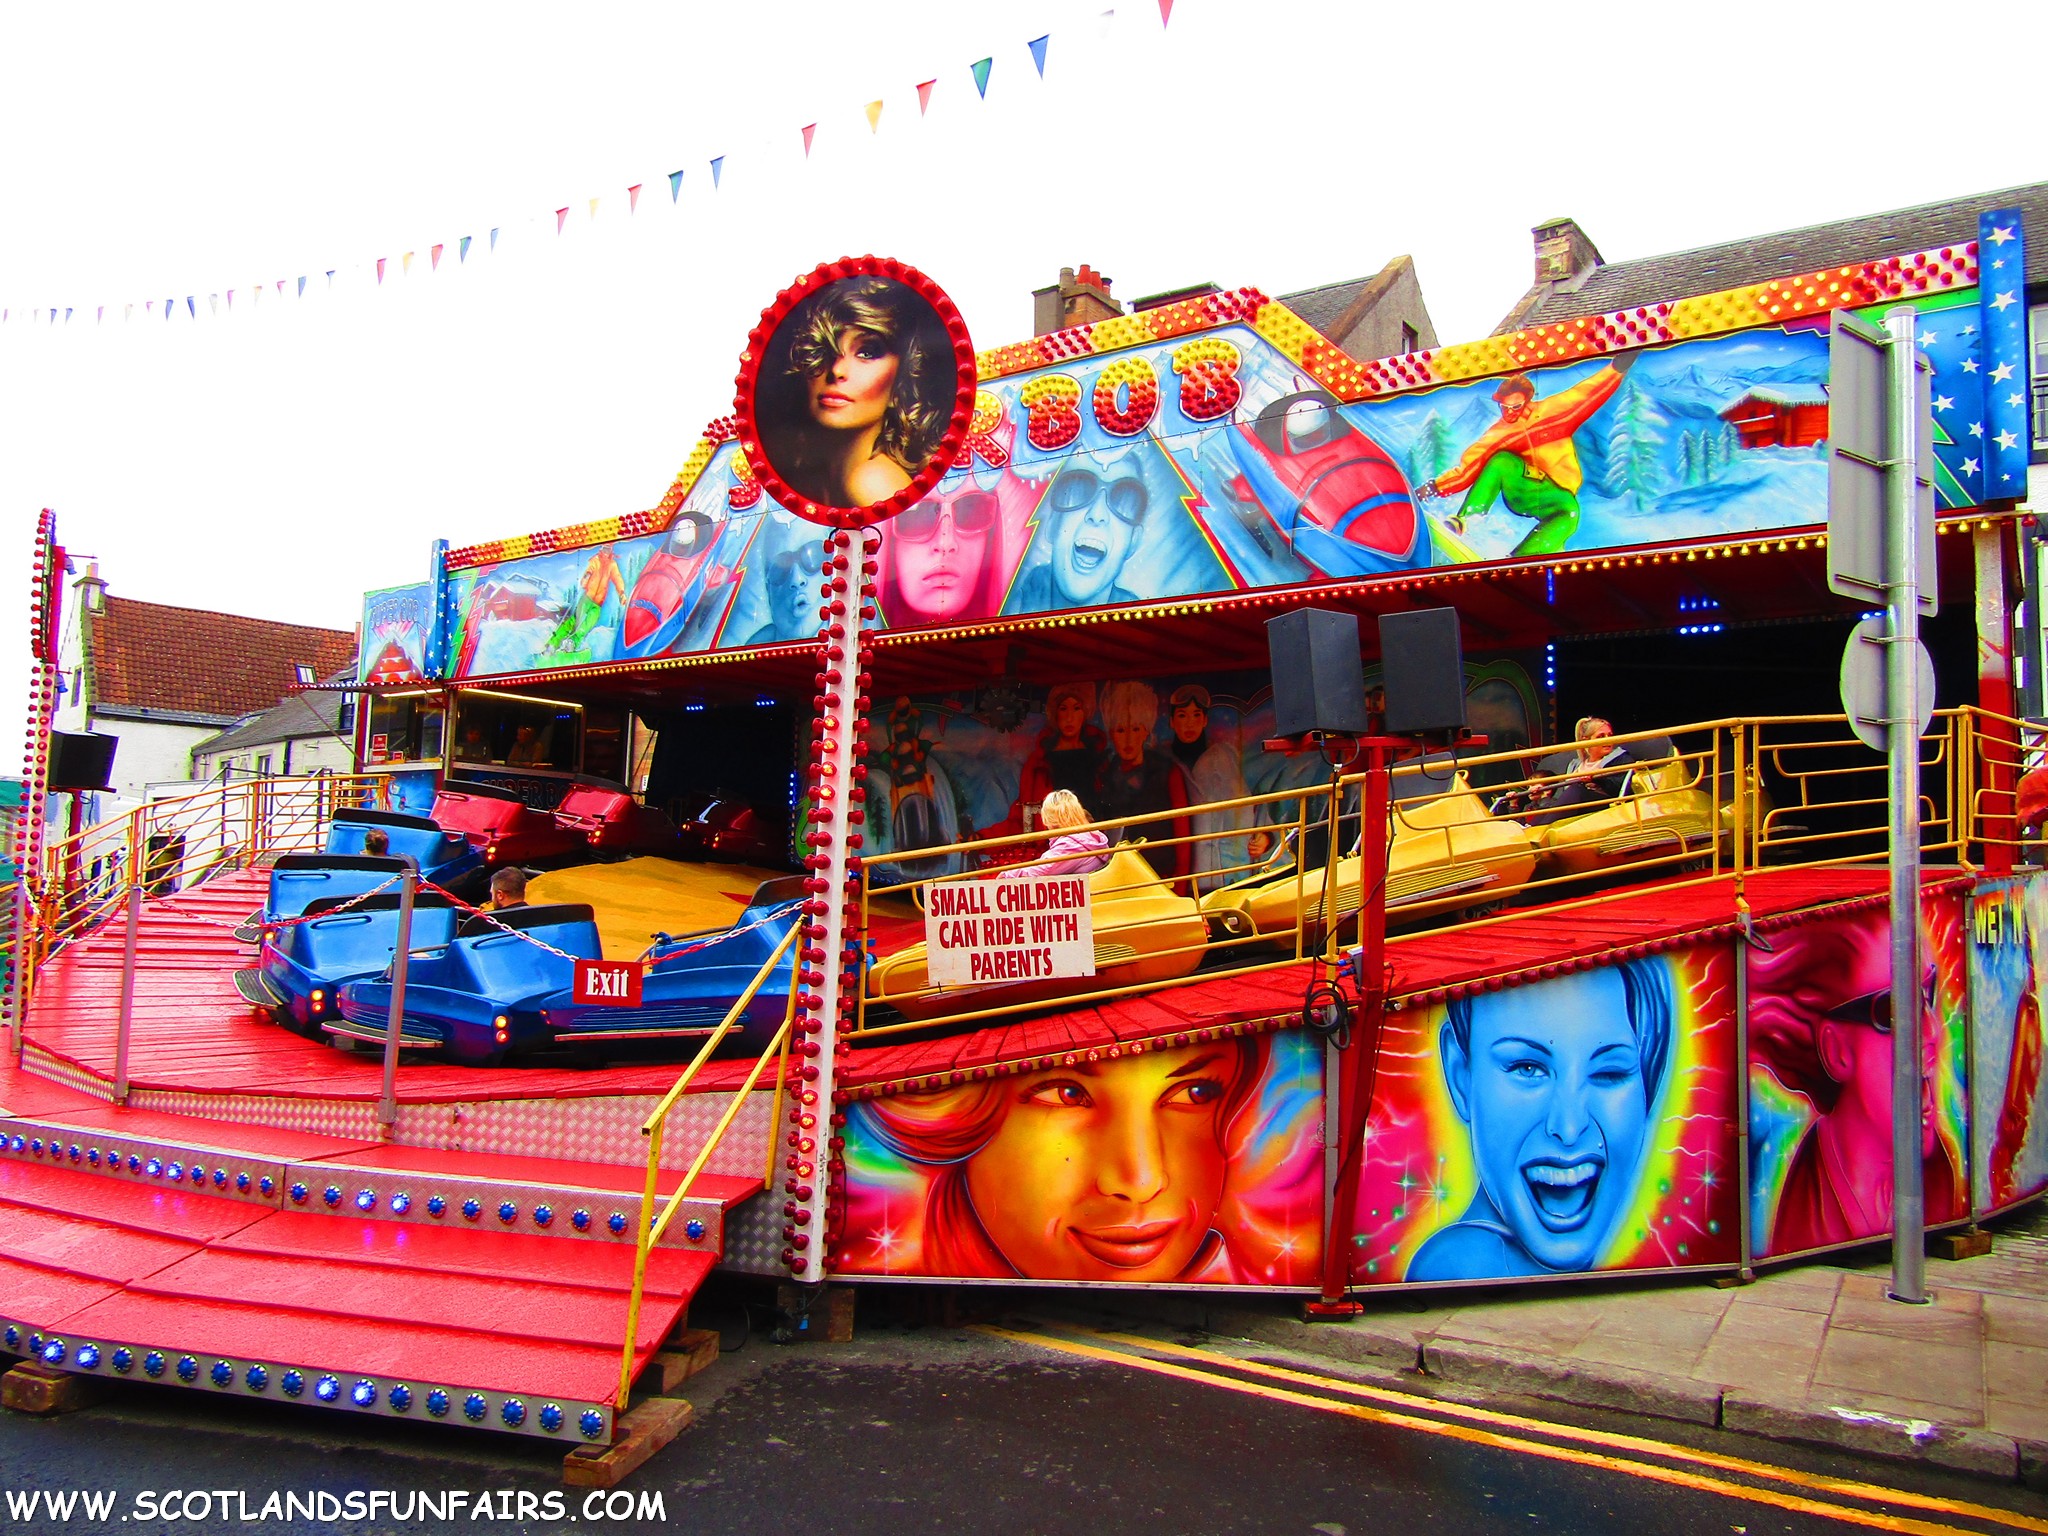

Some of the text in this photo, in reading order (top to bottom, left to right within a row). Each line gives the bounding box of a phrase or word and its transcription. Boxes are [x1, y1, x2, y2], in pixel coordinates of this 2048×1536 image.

[930, 879, 1085, 918] SMALL CHILDREN
[1973, 889, 2006, 944] WET
[938, 913, 1079, 949] CAN RIDE WITH
[585, 967, 629, 997] Exit
[970, 947, 1053, 981] PARENTS
